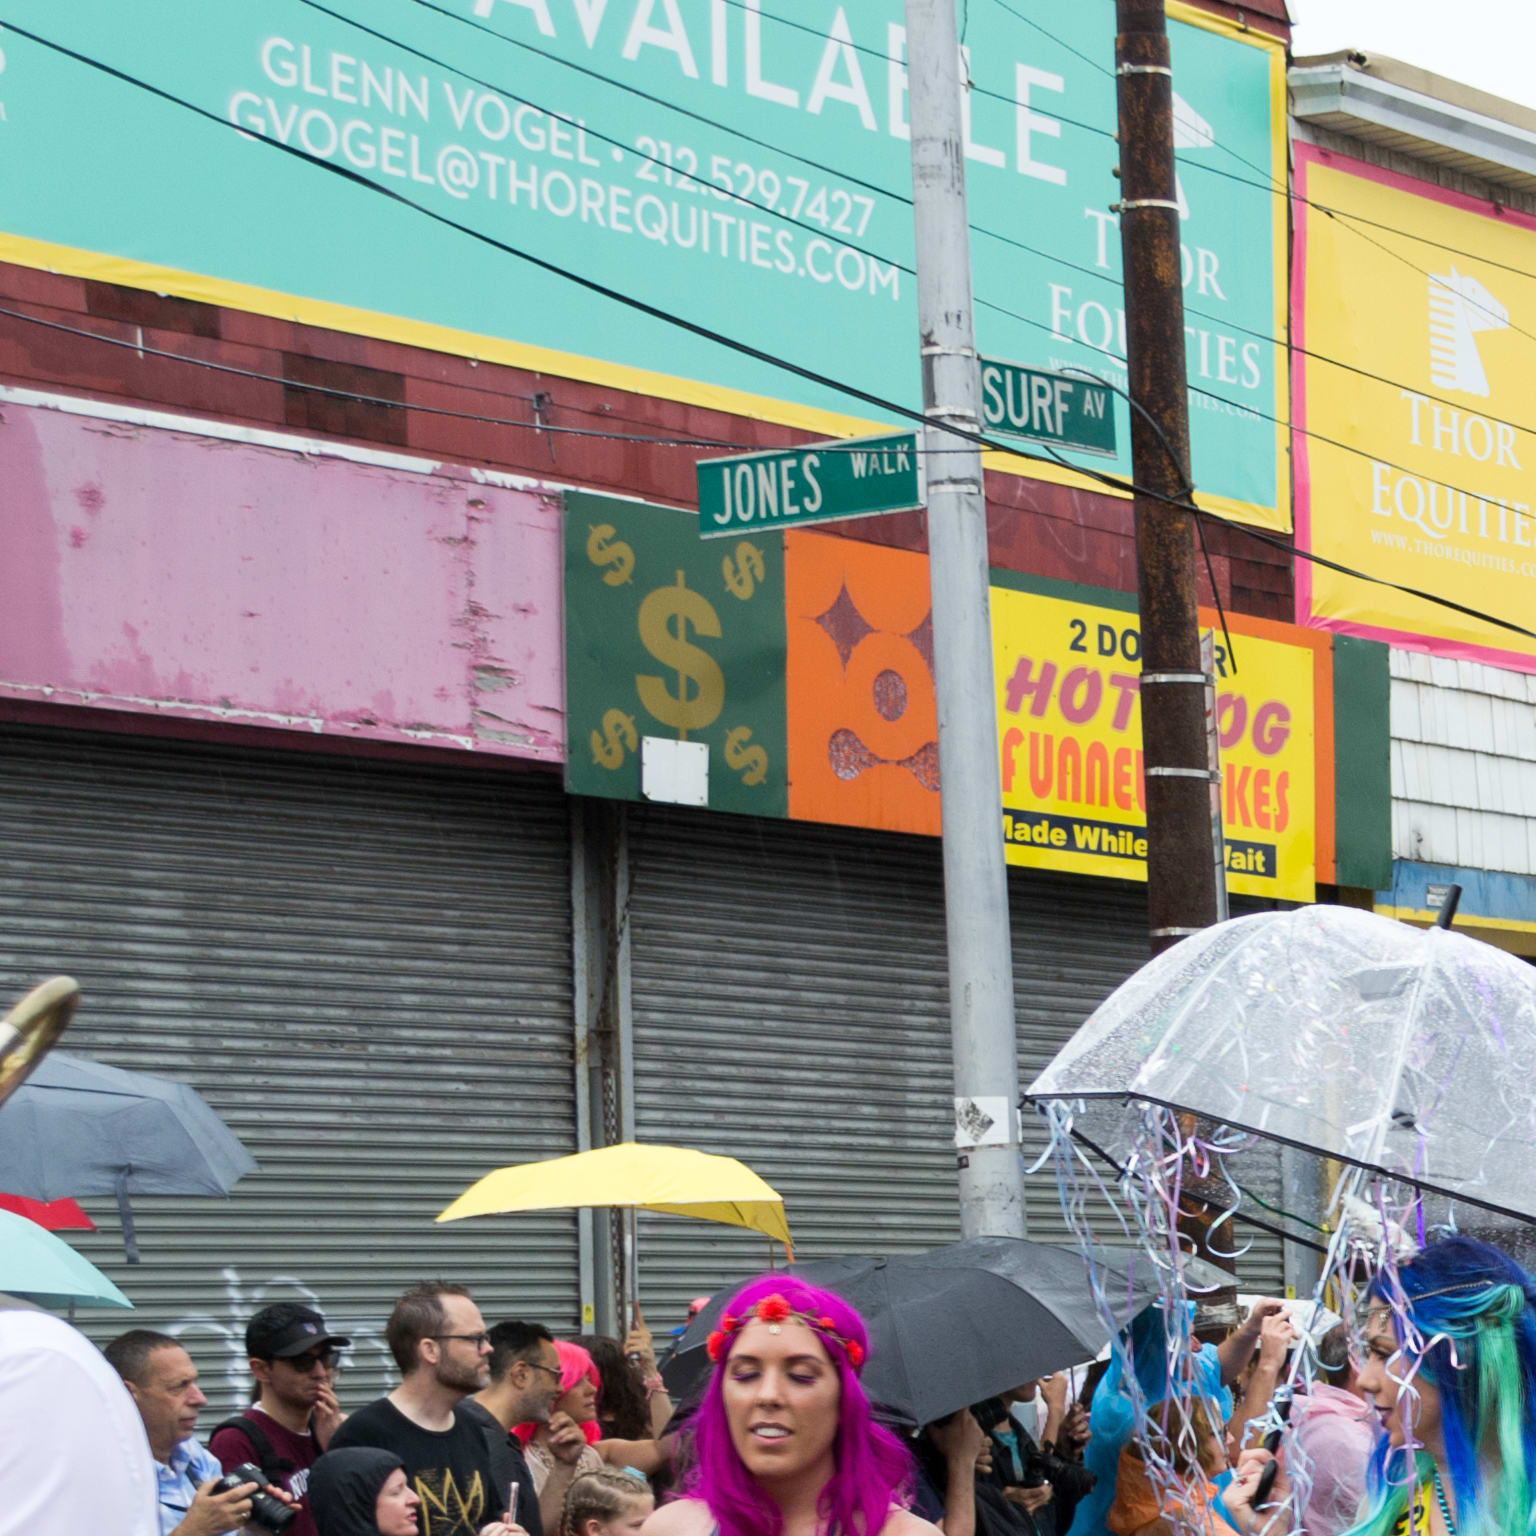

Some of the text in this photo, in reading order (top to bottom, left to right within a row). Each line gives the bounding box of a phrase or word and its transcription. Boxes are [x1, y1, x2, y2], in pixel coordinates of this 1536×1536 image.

[260, 36, 876, 238] GLENN VOGEL 212.529.7427
[228, 90, 901, 301] GVOGEL@THOREQUITIES.COM
[981, 367, 1107, 437] SURF AV
[1400, 388, 1523, 471] THOR
[712, 442, 912, 526] JONES WALK
[1069, 618, 1229, 679] 2 DOR
[1004, 655, 1292, 757] HOT OG
[1225, 762, 1290, 834] KES
[1073, 825, 1148, 858] While
[1224, 847, 1267, 873] ait
